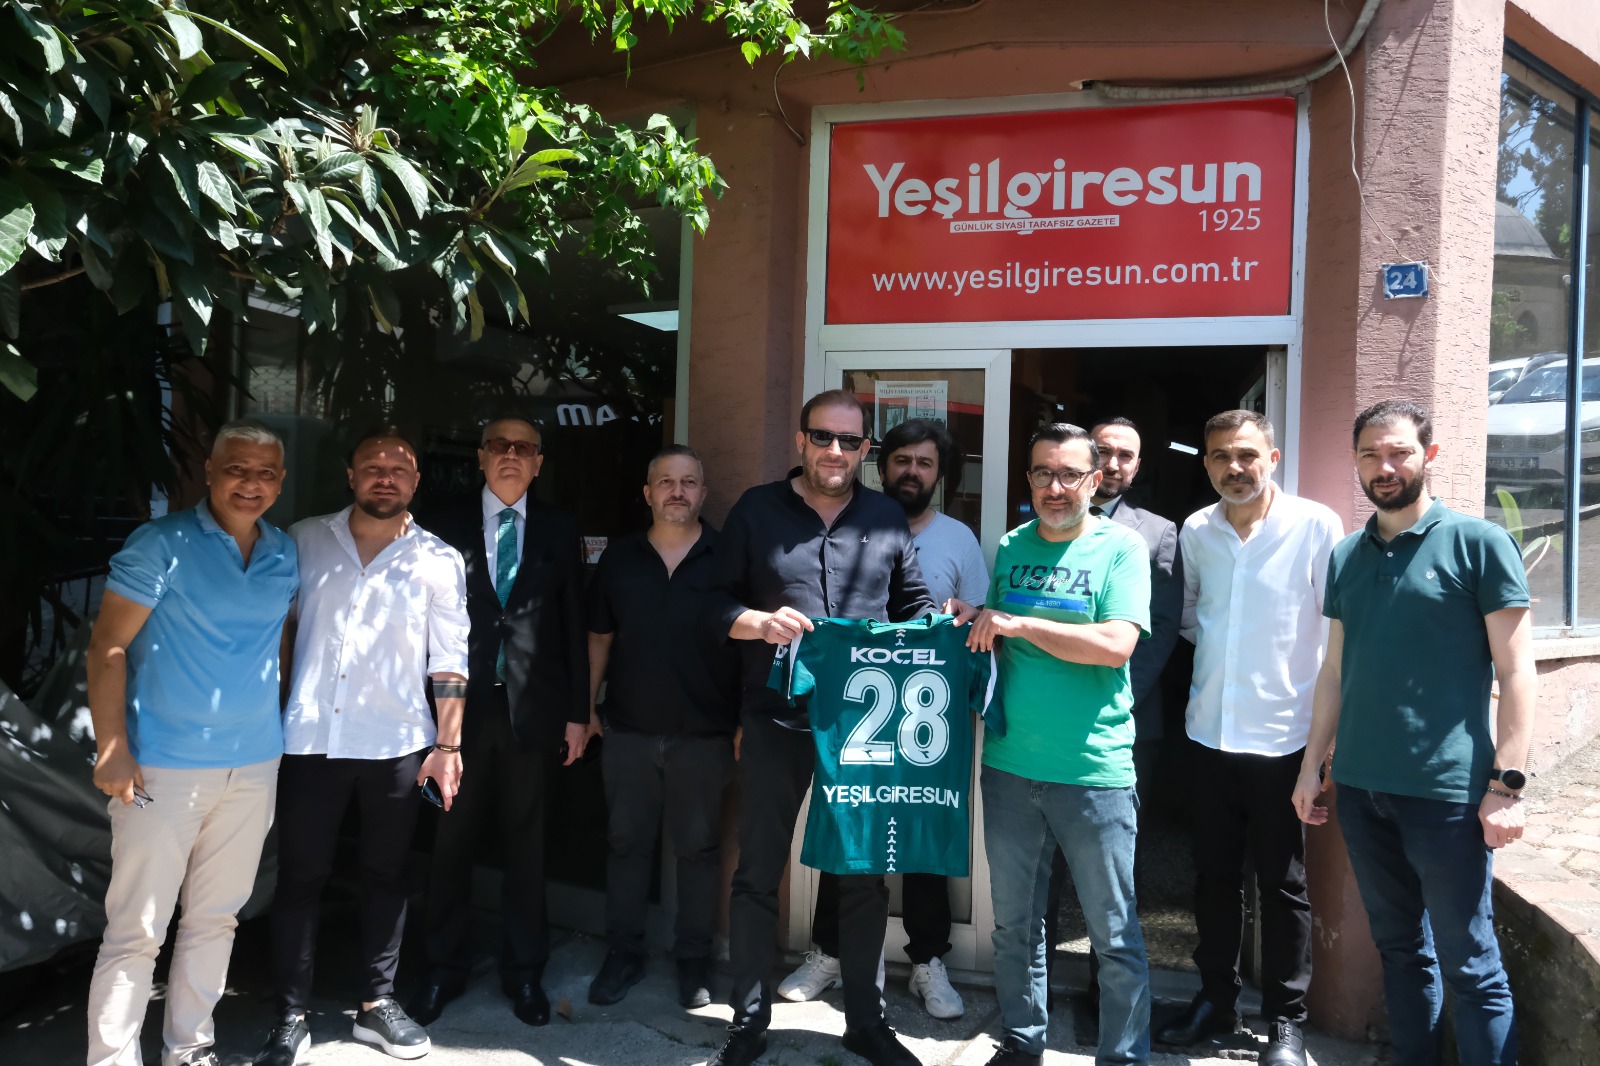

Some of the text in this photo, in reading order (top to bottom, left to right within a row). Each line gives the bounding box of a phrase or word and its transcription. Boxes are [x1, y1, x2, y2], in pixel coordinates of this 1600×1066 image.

[863, 157, 1262, 235] Yeşilgiresun
[953, 217, 1116, 232] GÜNLÜK SİYASİ TARAFSIZ GAZETE
[1198, 207, 1261, 232] 1925
[872, 256, 1259, 296] www.yesilgiresun.com.tr
[1389, 270, 1418, 290] 24
[1009, 565, 1093, 596] USPA
[850, 647, 947, 666] KOÇEL
[840, 666, 950, 767] 28
